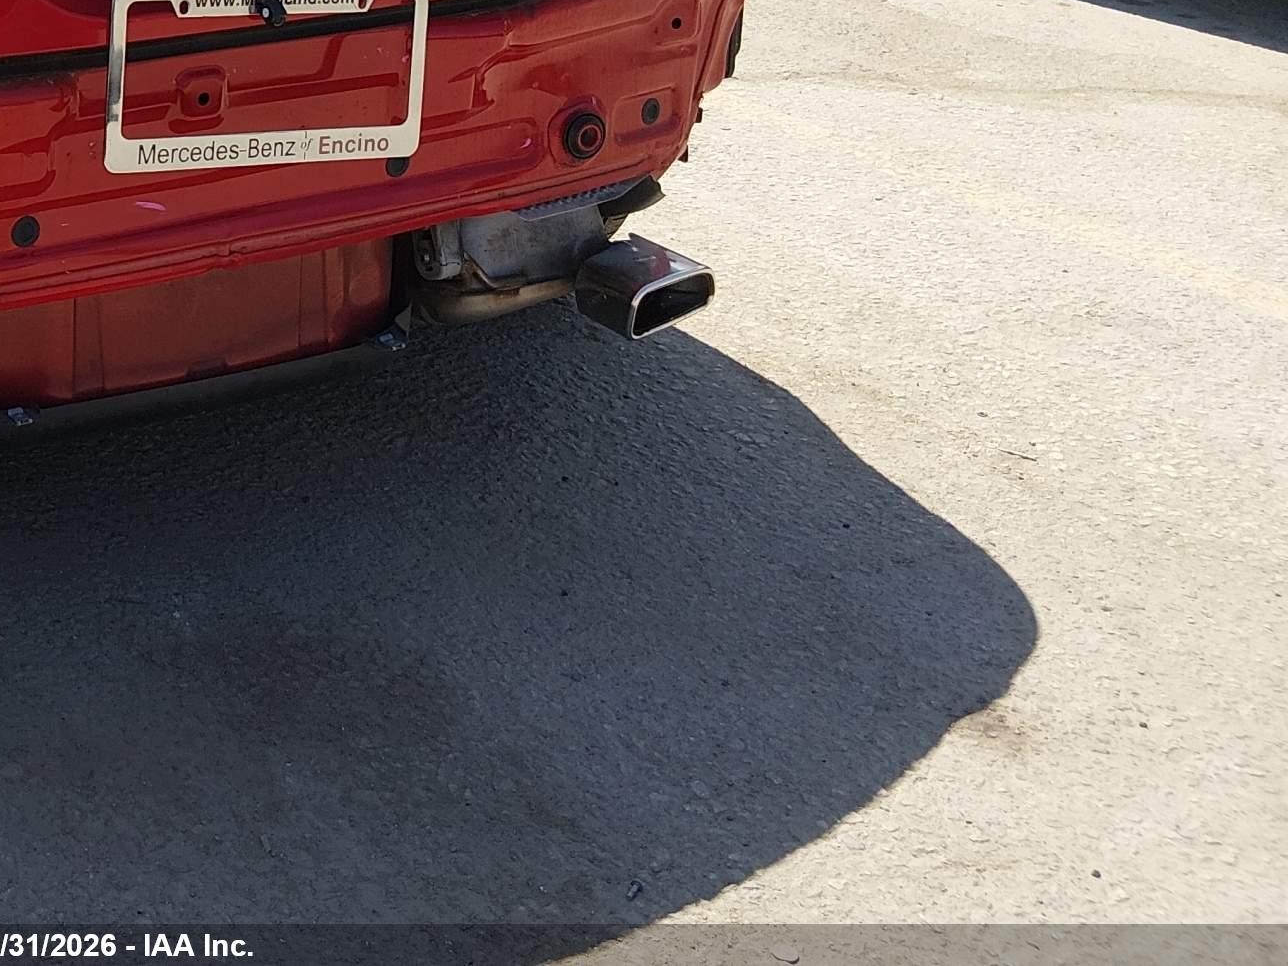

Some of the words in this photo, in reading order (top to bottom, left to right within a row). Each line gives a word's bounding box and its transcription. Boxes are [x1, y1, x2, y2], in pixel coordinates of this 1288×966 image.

[137, 138, 296, 165] Mercedes-Benz
[300, 138, 314, 152] of
[318, 132, 389, 155] Encino
